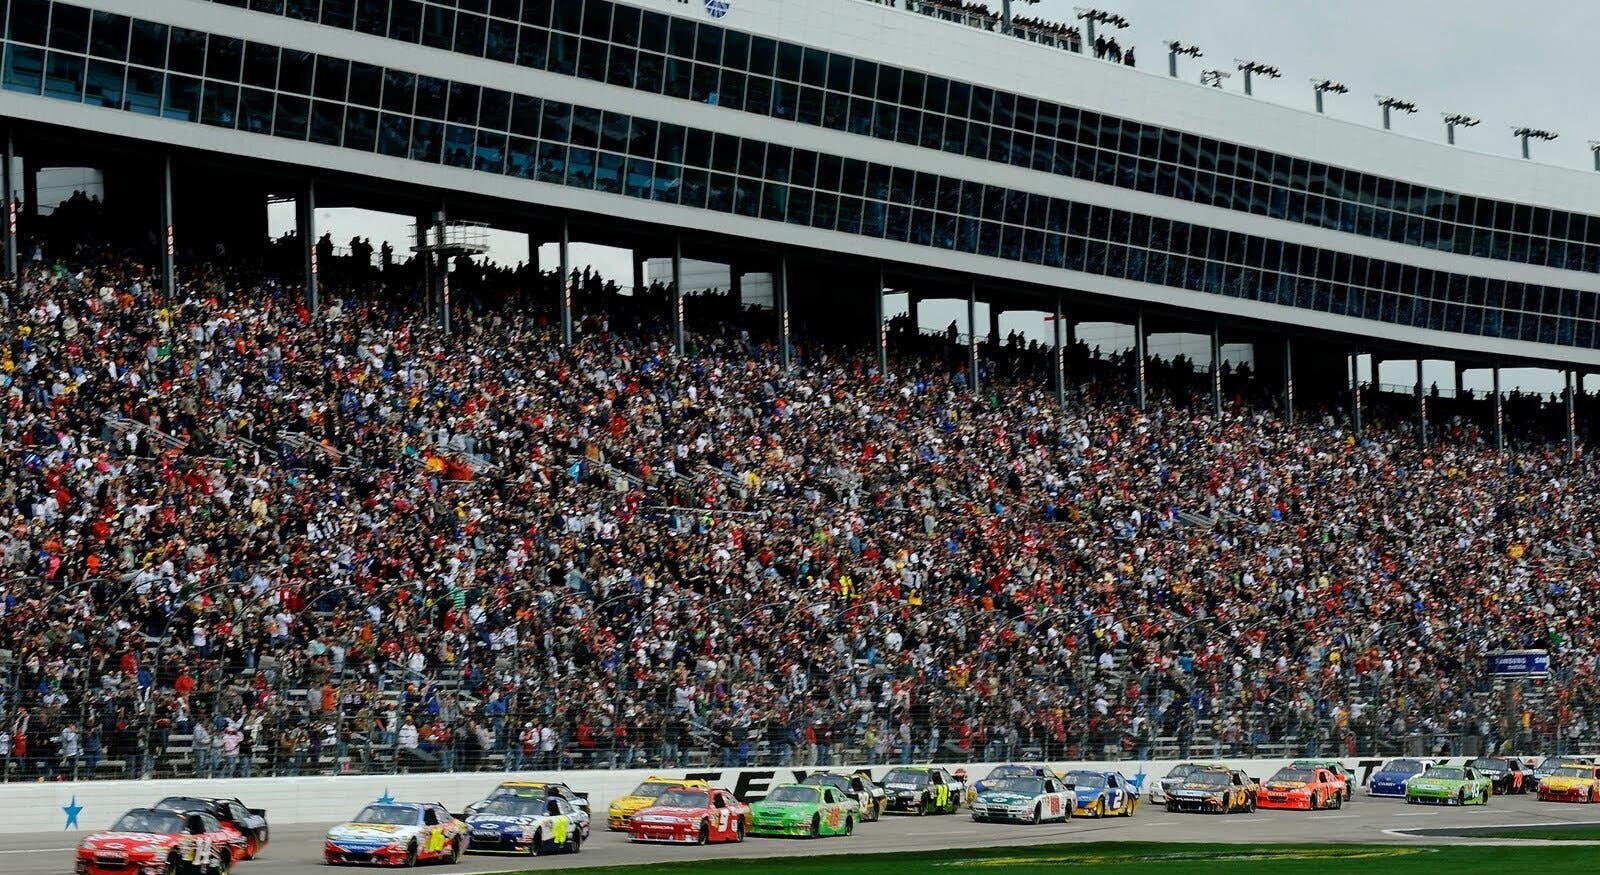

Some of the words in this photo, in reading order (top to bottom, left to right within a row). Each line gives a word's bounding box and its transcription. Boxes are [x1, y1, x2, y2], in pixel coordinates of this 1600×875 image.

[1050, 794, 1061, 816] 88
[1113, 788, 1124, 810] 2
[718, 808, 731, 832] 9
